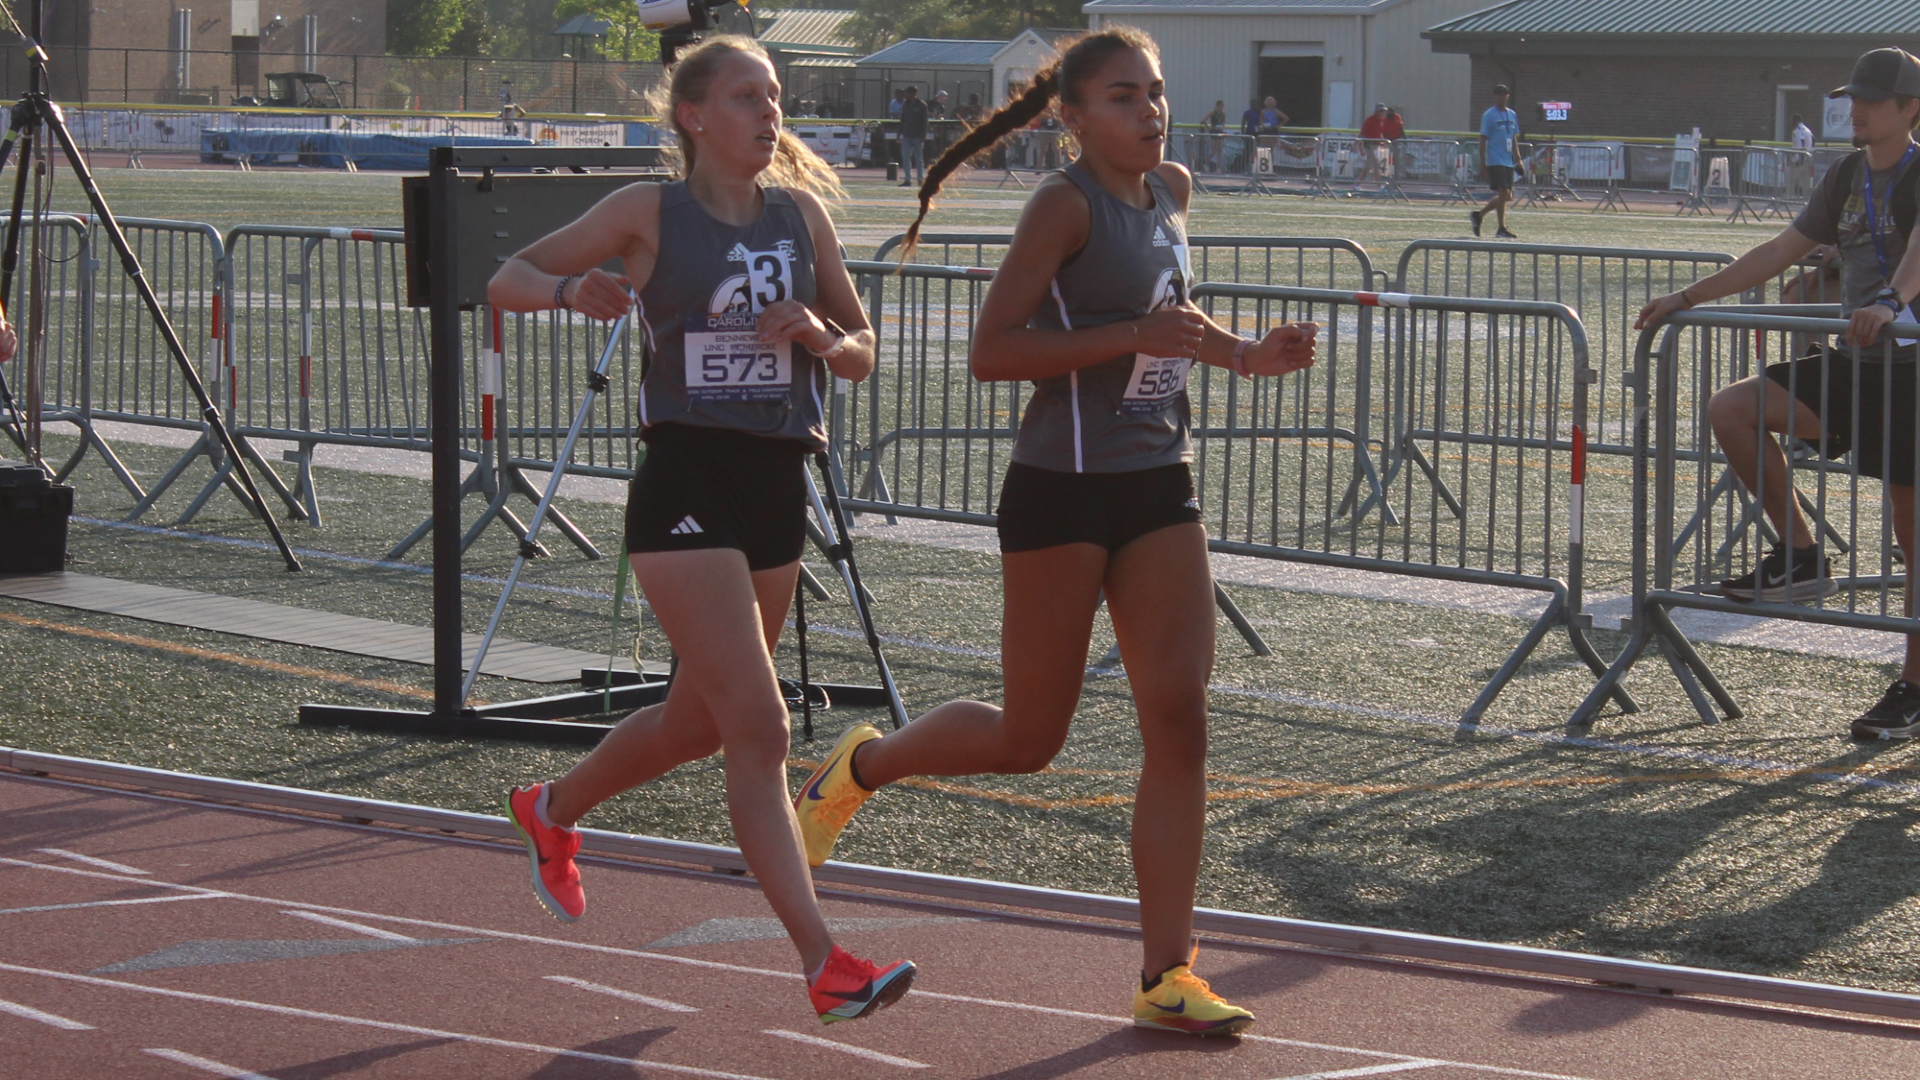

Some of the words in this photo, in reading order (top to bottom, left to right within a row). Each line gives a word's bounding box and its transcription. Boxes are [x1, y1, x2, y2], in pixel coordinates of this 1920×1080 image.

[1259, 157, 1269, 172] 8
[1337, 159, 1348, 175] 7
[1711, 169, 1722, 186] 2
[754, 254, 787, 308] 3
[704, 343, 725, 352] UNC
[729, 343, 777, 351] PEMBROKE
[701, 352, 779, 383] 573
[1145, 361, 1160, 369] UNC
[1138, 366, 1181, 395] 586
